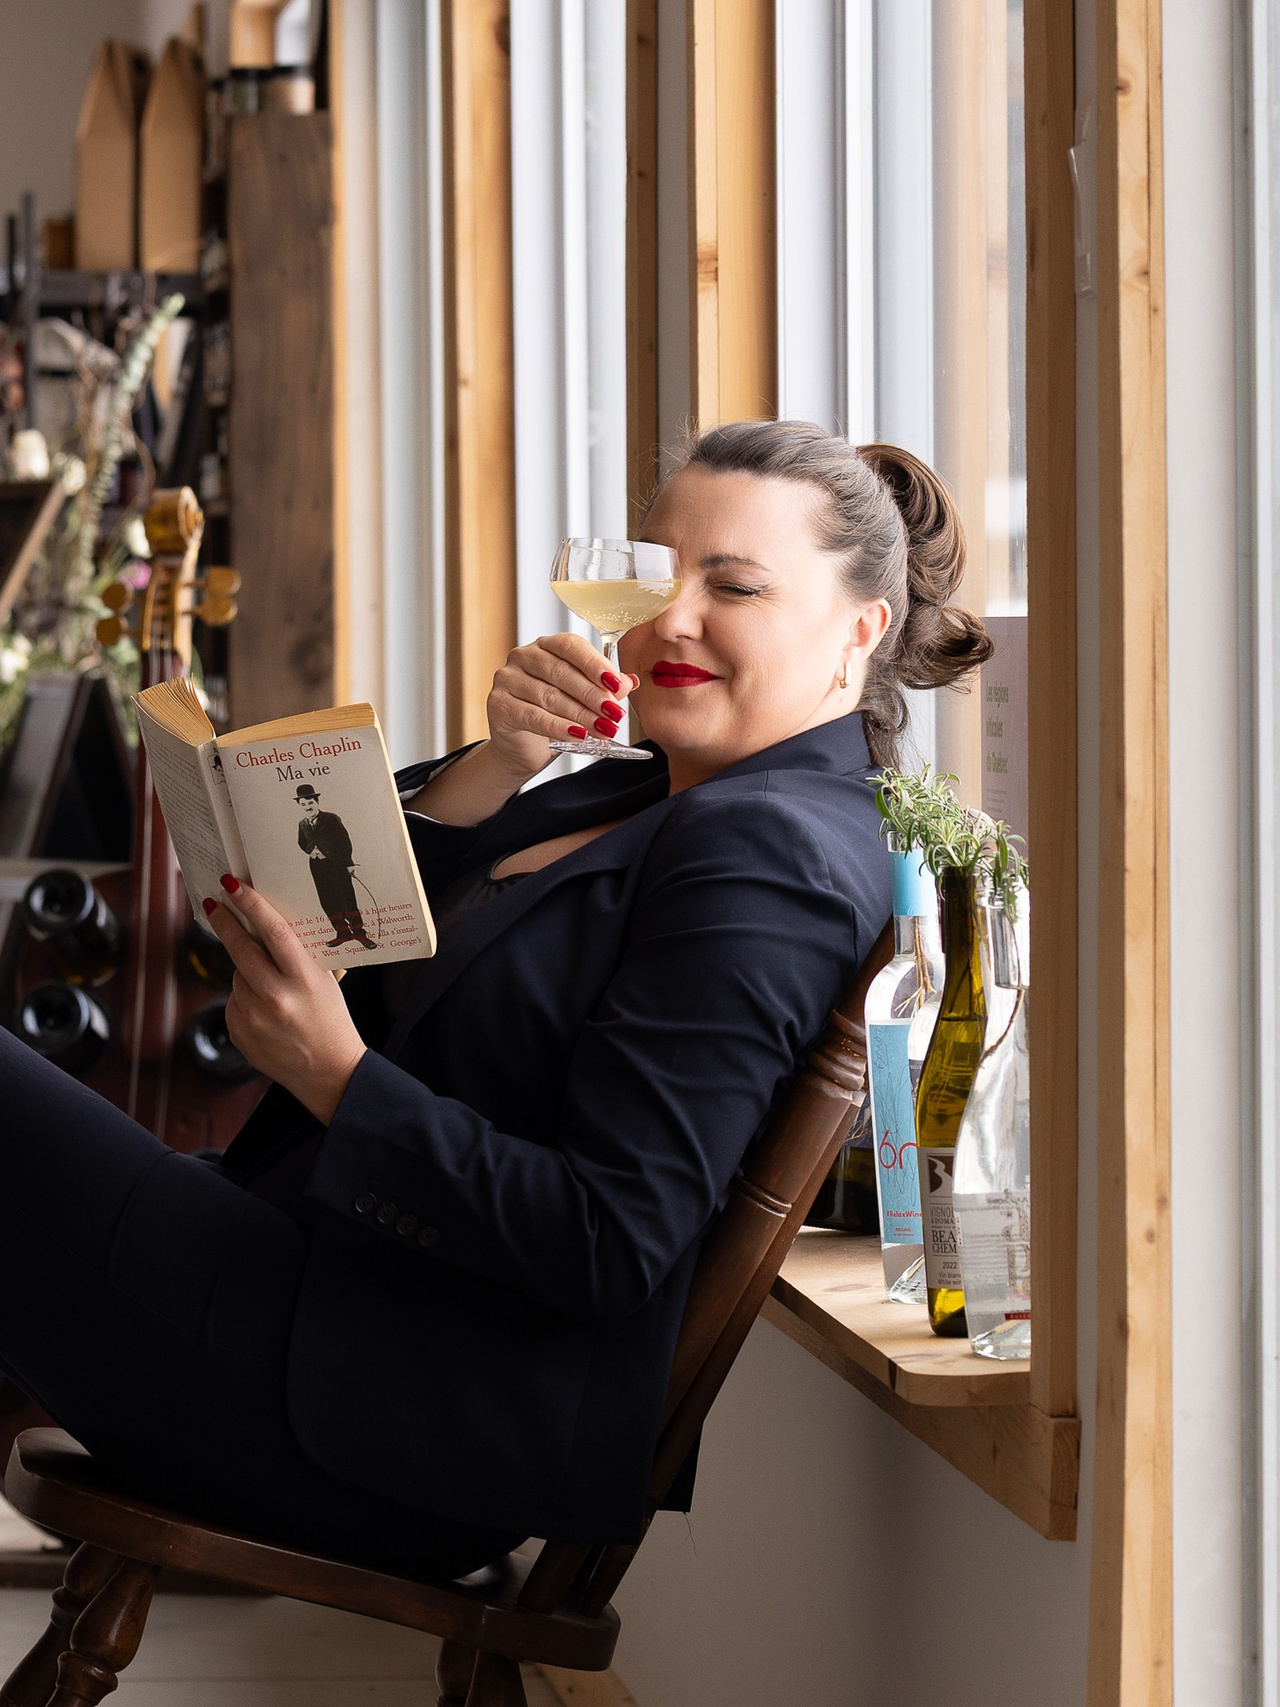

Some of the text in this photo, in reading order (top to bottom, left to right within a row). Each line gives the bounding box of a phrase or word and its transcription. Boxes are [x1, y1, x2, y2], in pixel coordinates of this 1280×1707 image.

[236, 737, 362, 768] Charles Chaplin
[276, 761, 331, 782] Ma vie
[388, 903, 413, 912] heures
[306, 917, 313, 925] le
[377, 913, 416, 925] Walworth.
[302, 929, 317, 937] soir
[318, 927, 335, 935] dans
[321, 949, 340, 958] West
[932, 1230, 957, 1243] BEA
[932, 1243, 958, 1254] CHEM
[942, 1261, 958, 1270] 2022
